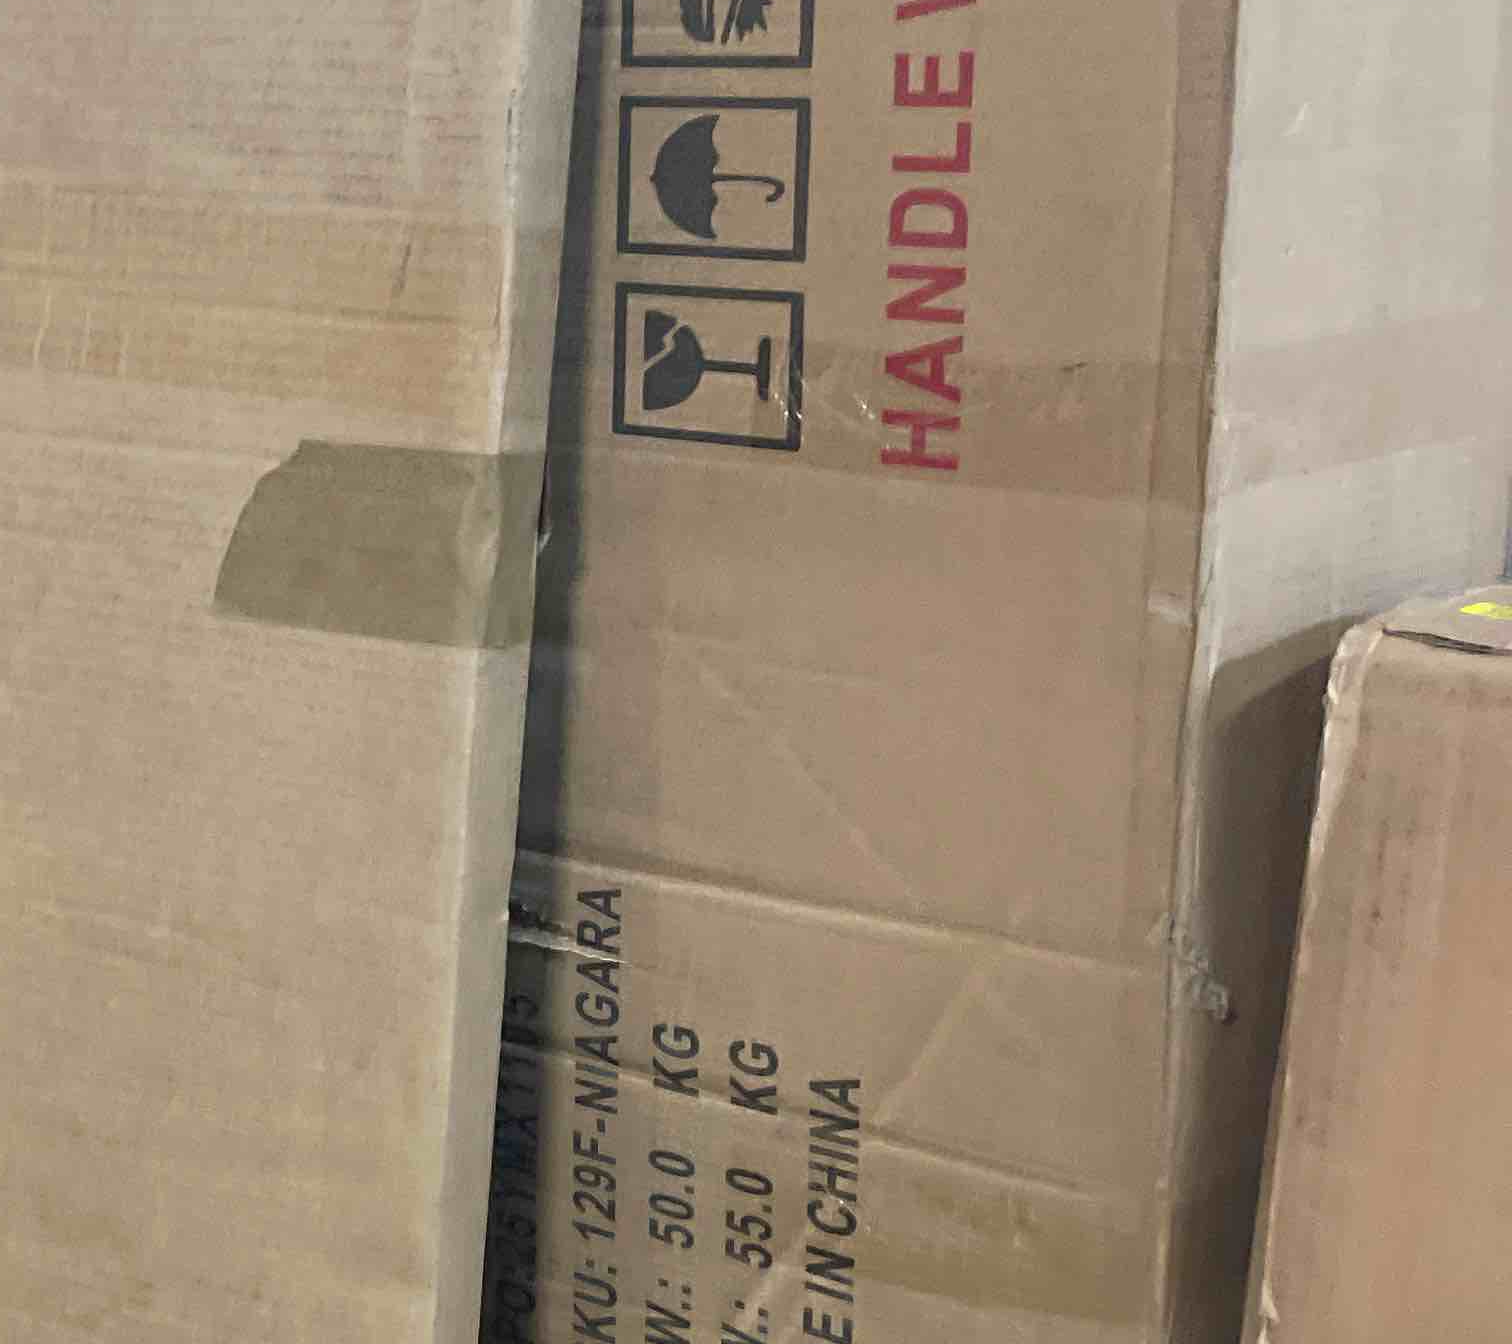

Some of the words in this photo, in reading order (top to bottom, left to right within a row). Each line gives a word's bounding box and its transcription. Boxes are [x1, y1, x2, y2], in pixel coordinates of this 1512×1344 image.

[880, 50, 975, 472] HANDLE
[573, 888, 621, 1241] 129F-NIAGARA
[652, 1022, 700, 1097] KG
[728, 1039, 778, 1116] KG
[648, 1149, 696, 1250] 50.0
[807, 1078, 860, 1238] CHINA
[724, 1167, 773, 1271] 55.0
[803, 1246, 856, 1304] IN
